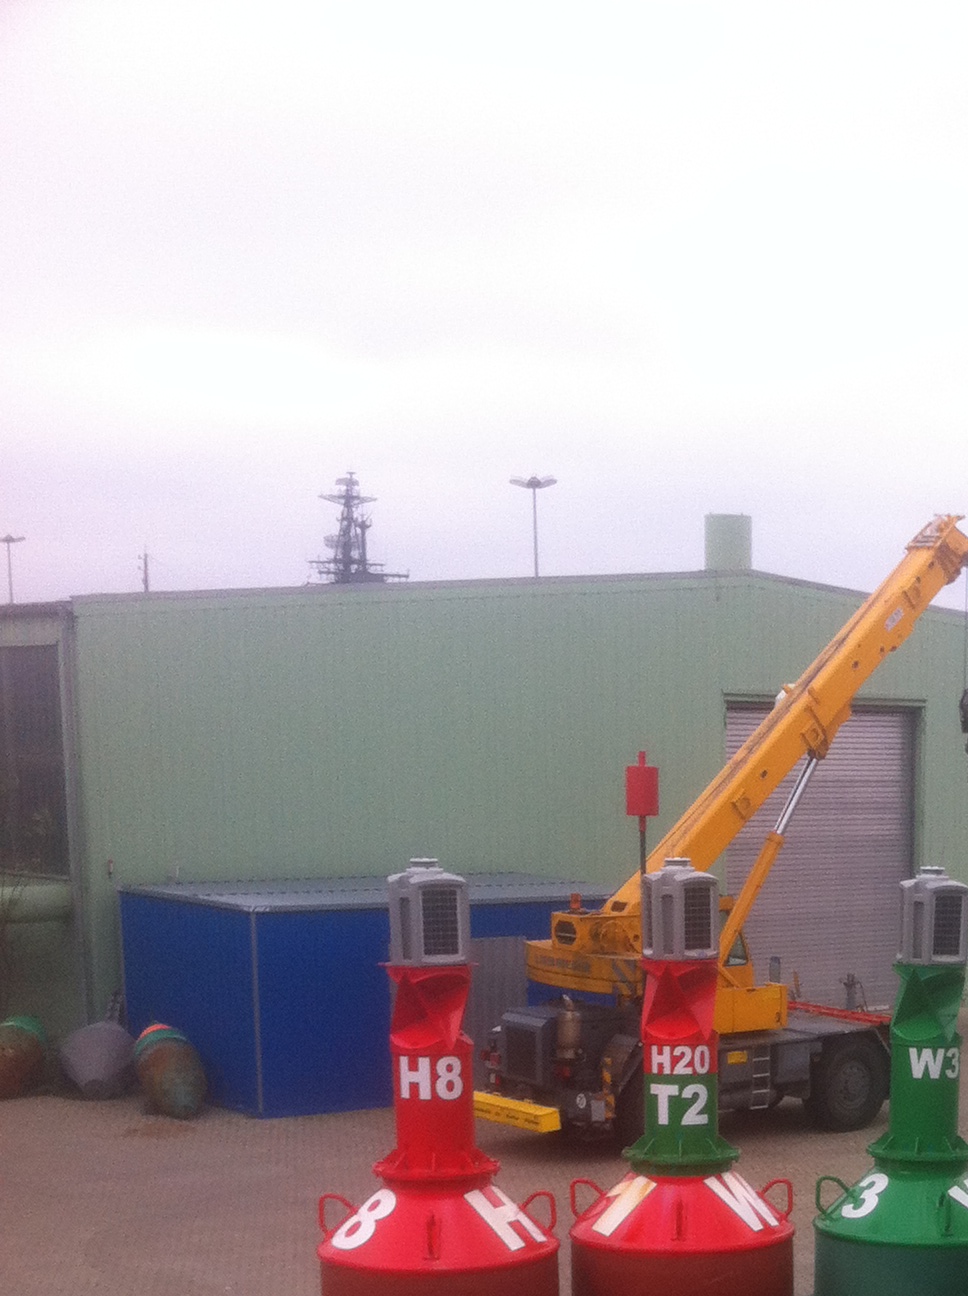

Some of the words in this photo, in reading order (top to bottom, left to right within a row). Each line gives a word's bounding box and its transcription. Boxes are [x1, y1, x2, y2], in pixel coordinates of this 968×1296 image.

[399, 1055, 463, 1100] H8
[651, 1044, 710, 1075] H20
[909, 1047, 959, 1079] W3
[650, 1083, 709, 1125] T2
[463, 1185, 548, 1251] H
[841, 1173, 889, 1219] 3
[331, 1188, 397, 1250] 8
